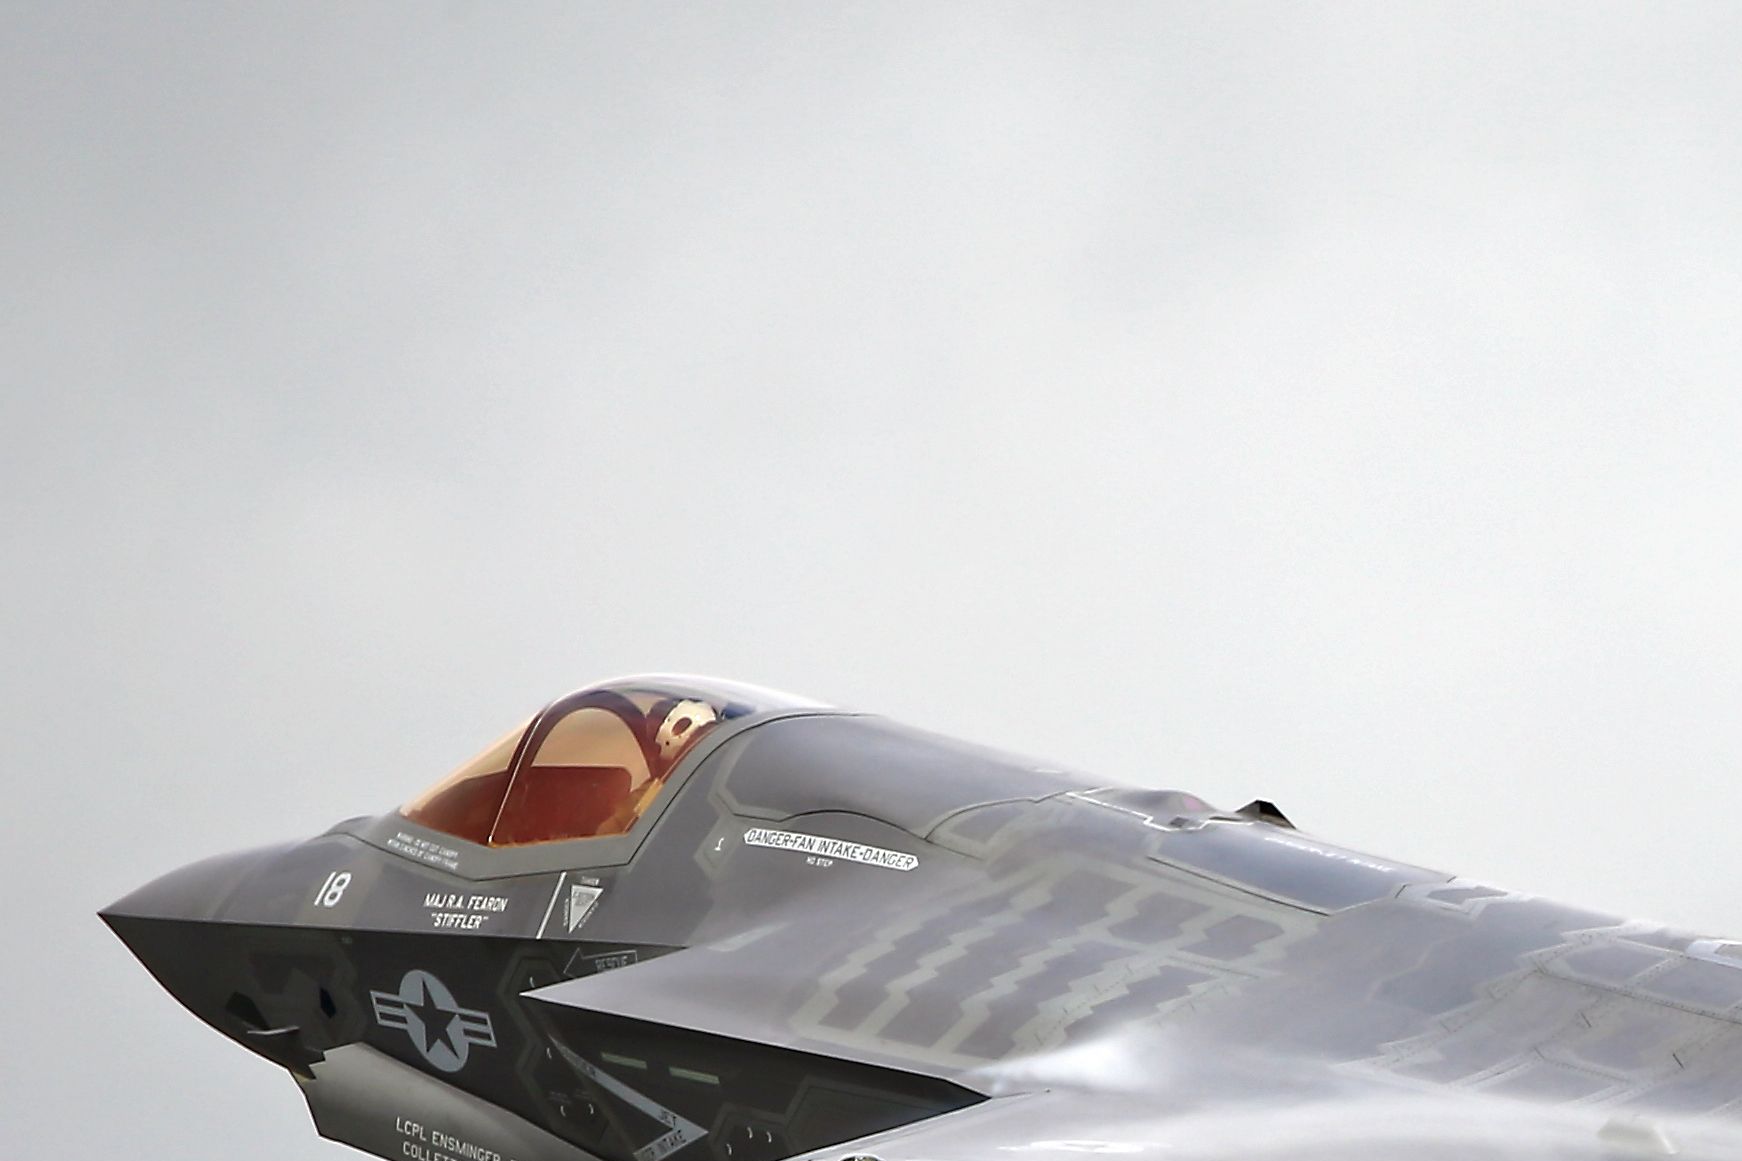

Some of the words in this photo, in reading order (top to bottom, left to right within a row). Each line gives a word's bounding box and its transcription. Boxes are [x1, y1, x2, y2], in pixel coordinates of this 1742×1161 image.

[314, 871, 352, 907] 18
[467, 895, 508, 912] FEARON
[396, 1116, 427, 1141] LCPL
